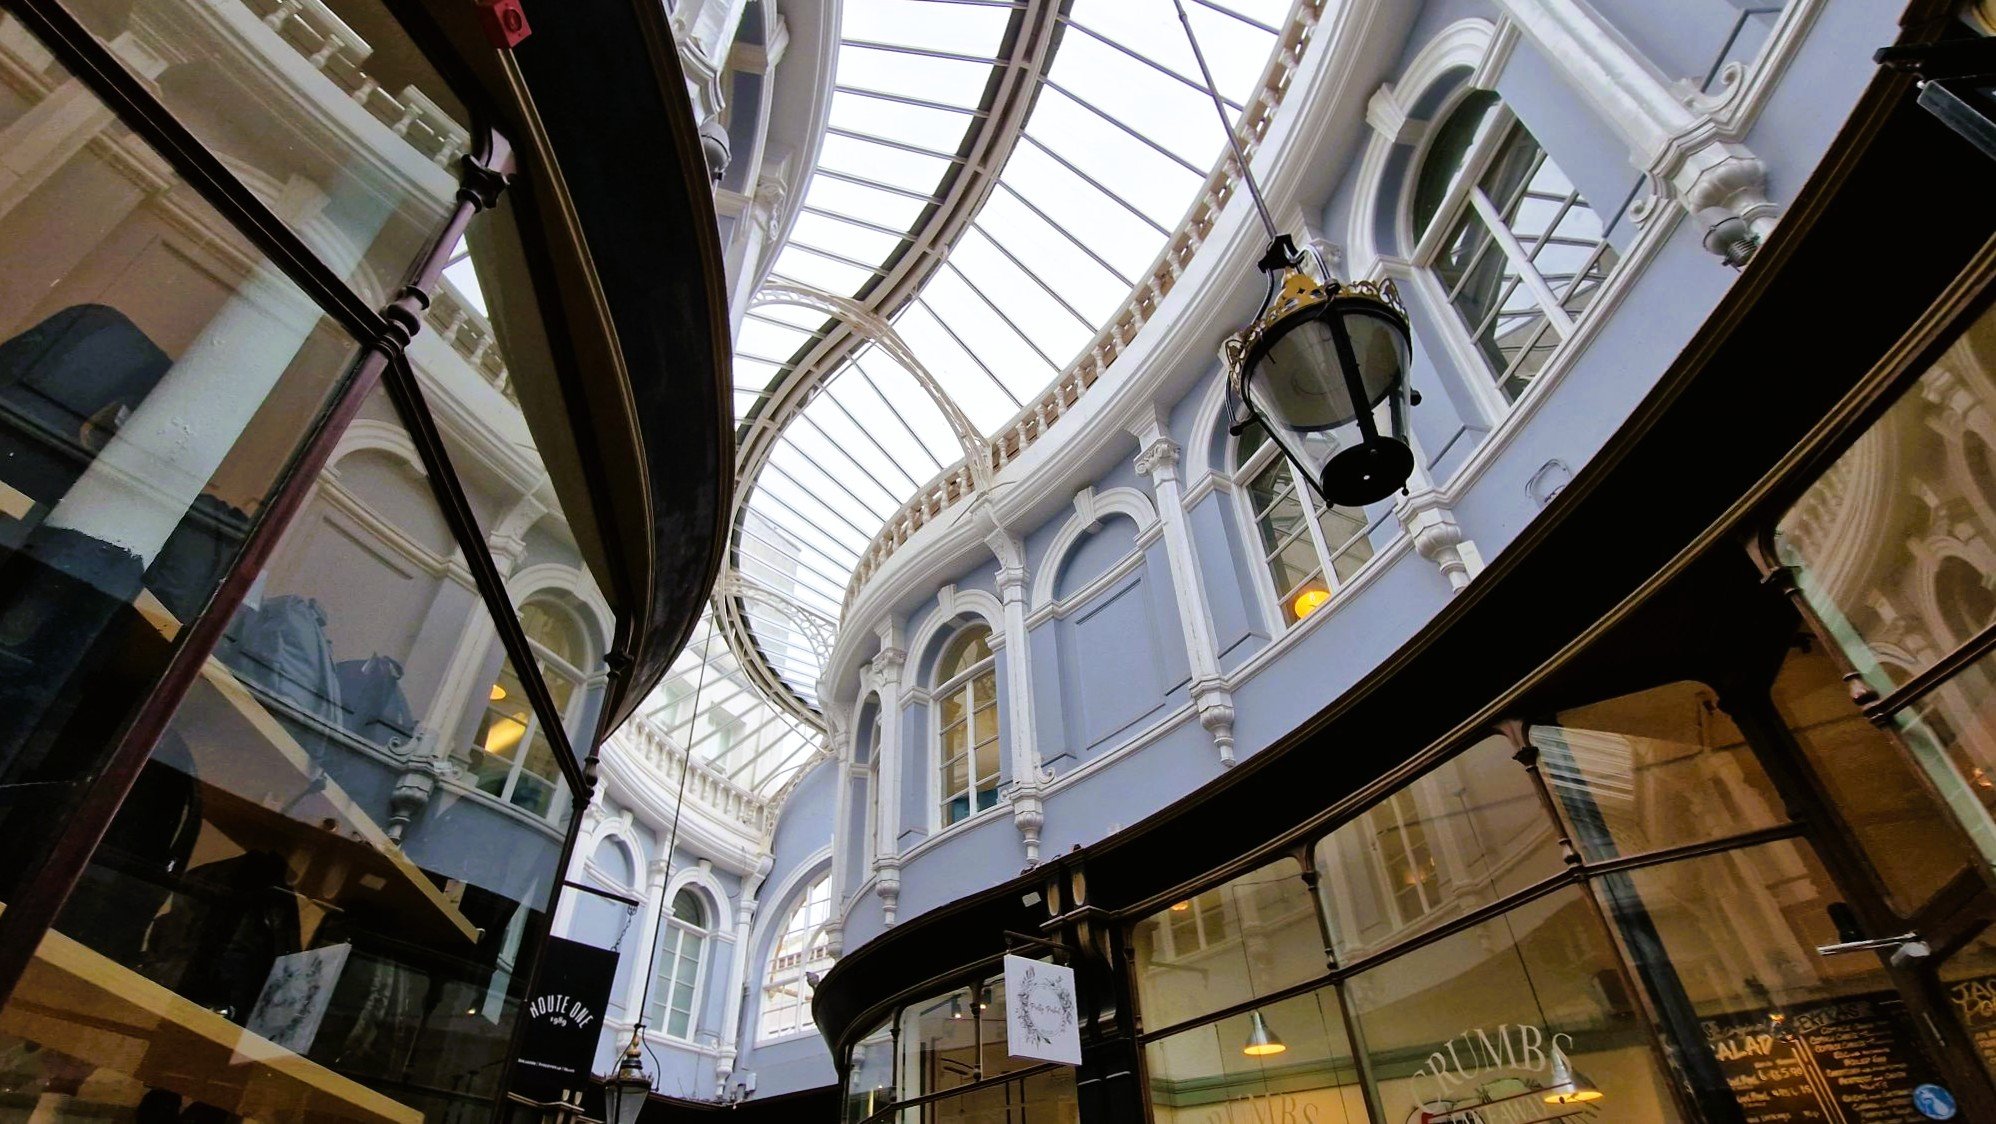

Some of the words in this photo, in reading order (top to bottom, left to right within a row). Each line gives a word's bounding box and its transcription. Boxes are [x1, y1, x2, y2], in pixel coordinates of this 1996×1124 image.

[549, 1016, 568, 1028] 1989
[569, 1001, 594, 1029] ONE
[1710, 1034, 1774, 1062] ALAD
[1411, 1023, 1573, 1114] CRUMBS
